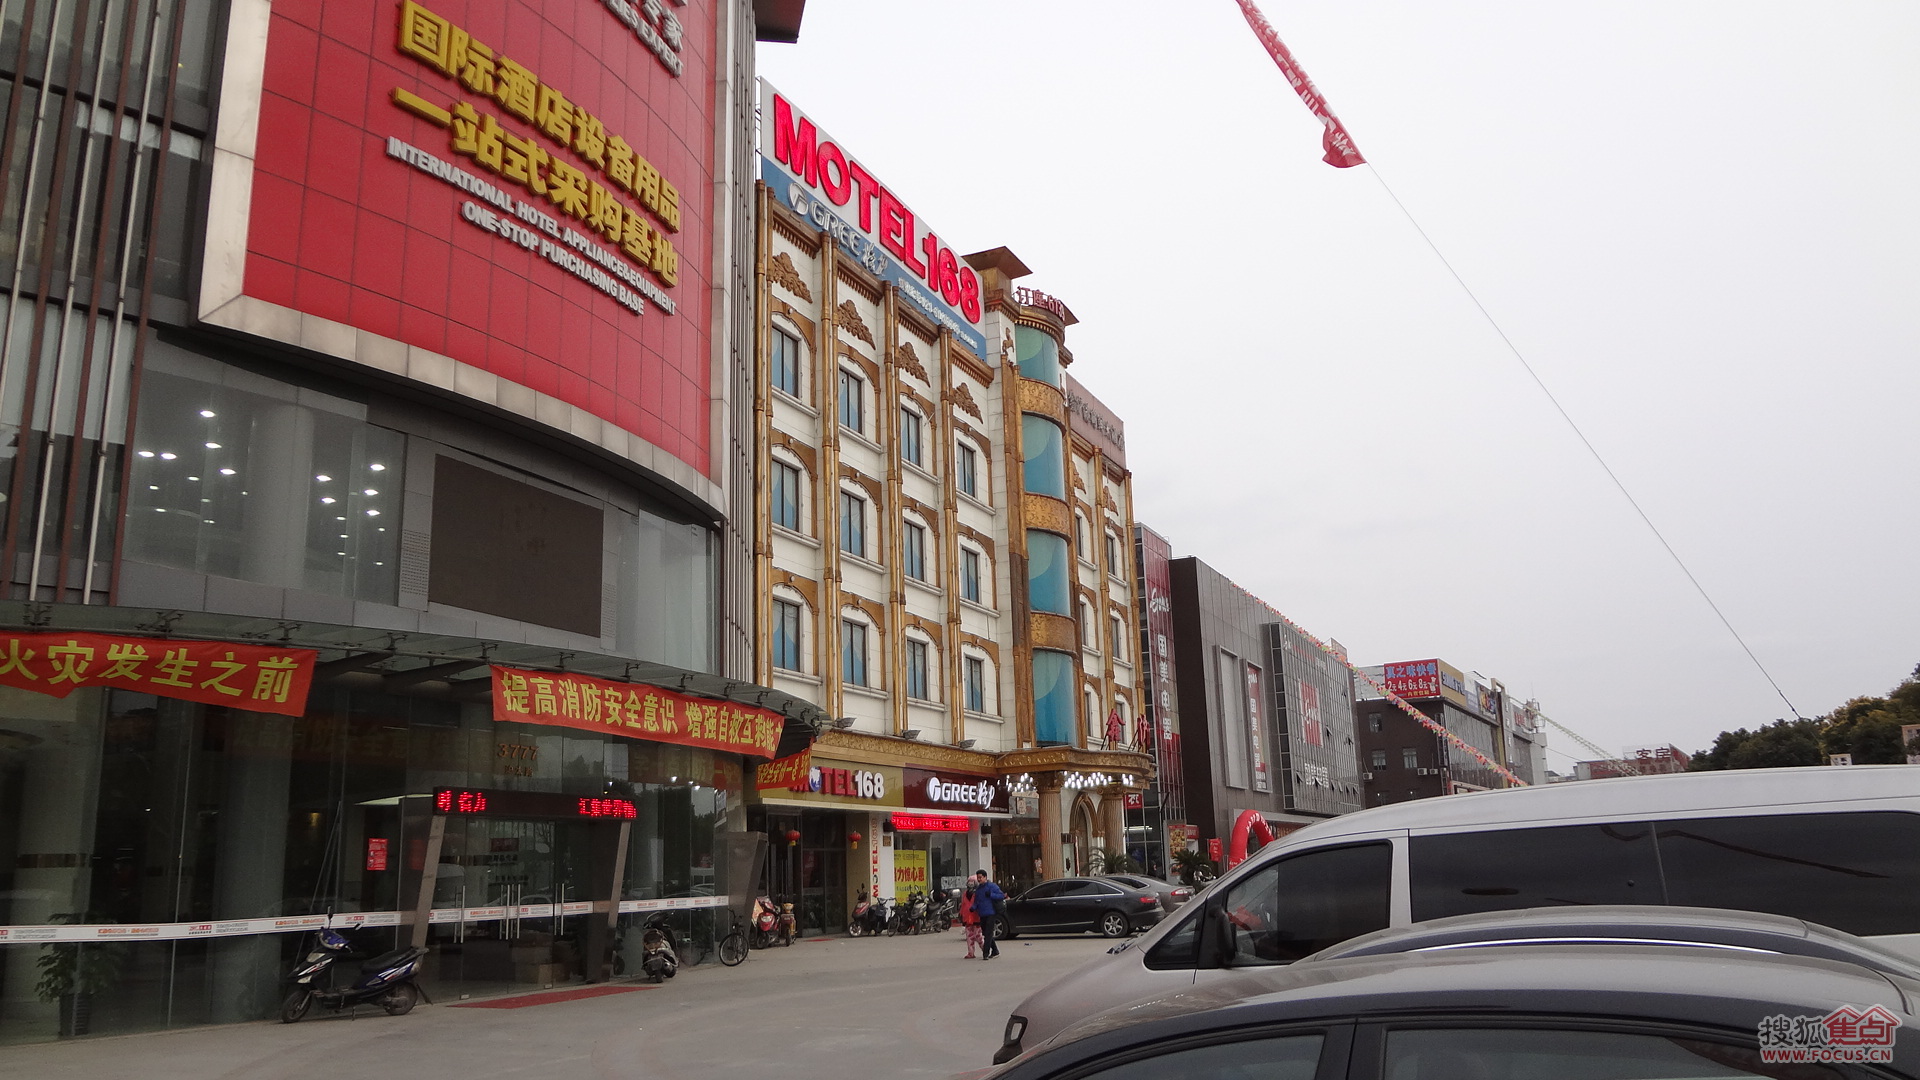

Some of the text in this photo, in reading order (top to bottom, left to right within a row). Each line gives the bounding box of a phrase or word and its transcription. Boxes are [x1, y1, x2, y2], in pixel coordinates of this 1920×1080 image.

[637, 18, 684, 77] EXPERT
[398, 0, 681, 233] 国际酒店设备用品
[387, 136, 677, 316] INTERNATIONAL HOTEL APPLIANCE&EQUIPMENT
[391, 87, 679, 288] 一站式采购基地
[774, 93, 981, 325] MOTEL168
[809, 200, 860, 257] GREE
[462, 201, 645, 317] ONE-STOP PURCHASING BASE
[0, 639, 298, 703] 火灾发生之前
[501, 672, 678, 734] 提高消防安全意识
[1156, 633, 1174, 741] 国美电器
[497, 743, 540, 761] 3777
[941, 782, 978, 803] GREE
